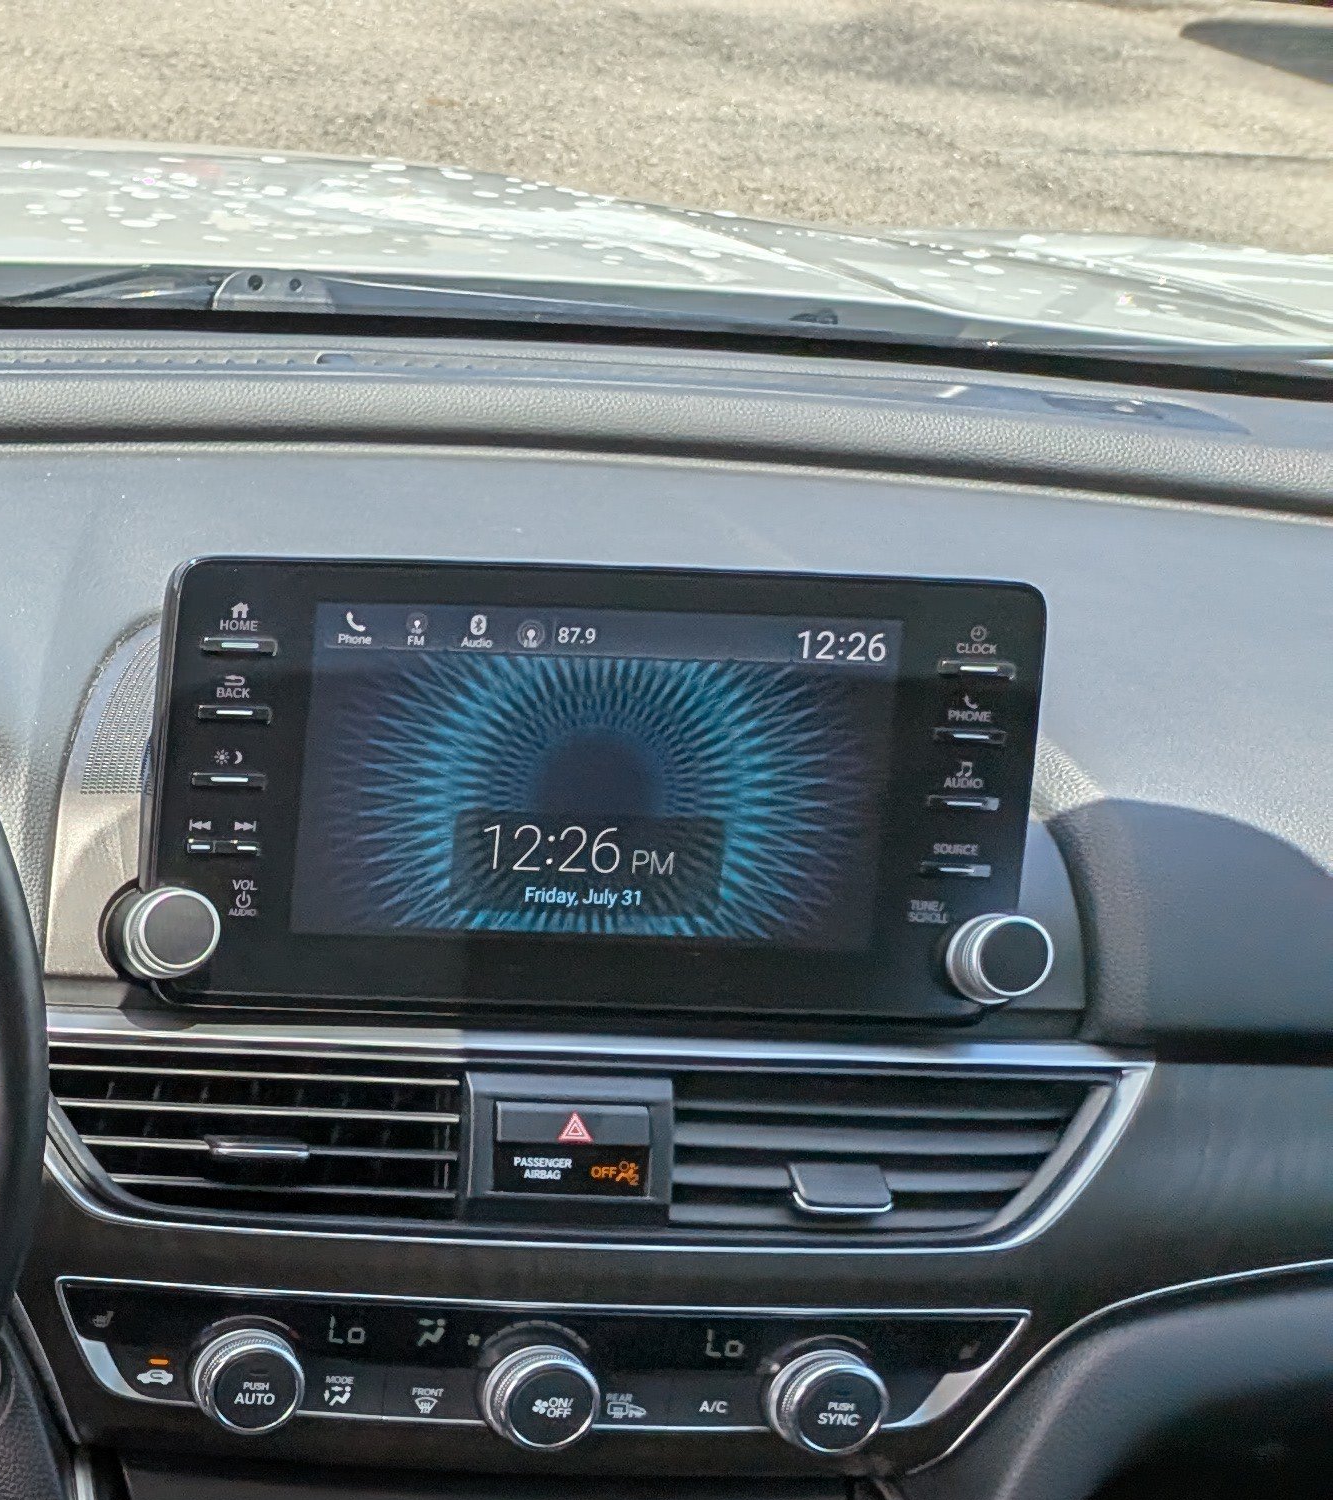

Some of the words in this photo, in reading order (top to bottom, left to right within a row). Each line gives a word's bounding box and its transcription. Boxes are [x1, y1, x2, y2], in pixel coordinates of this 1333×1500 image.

[219, 619, 259, 632] HOME
[337, 633, 372, 645] Phone
[407, 635, 425, 646] FM
[557, 626, 597, 645] 87.9
[460, 636, 493, 649] Audio
[797, 630, 887, 662] 12:26
[956, 643, 998, 656] CLOCK
[216, 687, 251, 700] BACK
[948, 710, 992, 724] PHONE
[943, 777, 984, 789] AUDIO
[483, 824, 621, 874] 12:26
[631, 849, 675, 876] PM
[933, 843, 979, 856] SOURCE
[231, 878, 258, 892] VOL
[524, 886, 579, 908] Friday,
[582, 888, 617, 909] July
[621, 890, 643, 906] 31
[909, 900, 944, 912] TUNE/
[228, 908, 258, 918] AUDIO
[907, 910, 949, 924] SCROLL
[513, 1156, 573, 1170] PASSENGER
[523, 1169, 562, 1180] AIRBAG
[590, 1166, 618, 1178] OFF
[327, 1315, 366, 1345] Lo
[705, 1328, 745, 1358] Lo
[243, 1380, 270, 1391] PUSH
[325, 1375, 355, 1385] MODE
[234, 1392, 275, 1406] AUTO
[412, 1387, 445, 1398] FRONT
[547, 1396, 575, 1409] ON/
[699, 1400, 729, 1414] A/C
[827, 1402, 855, 1412] PUSH
[547, 1406, 572, 1419] OFF
[817, 1412, 861, 1428] SYNC
